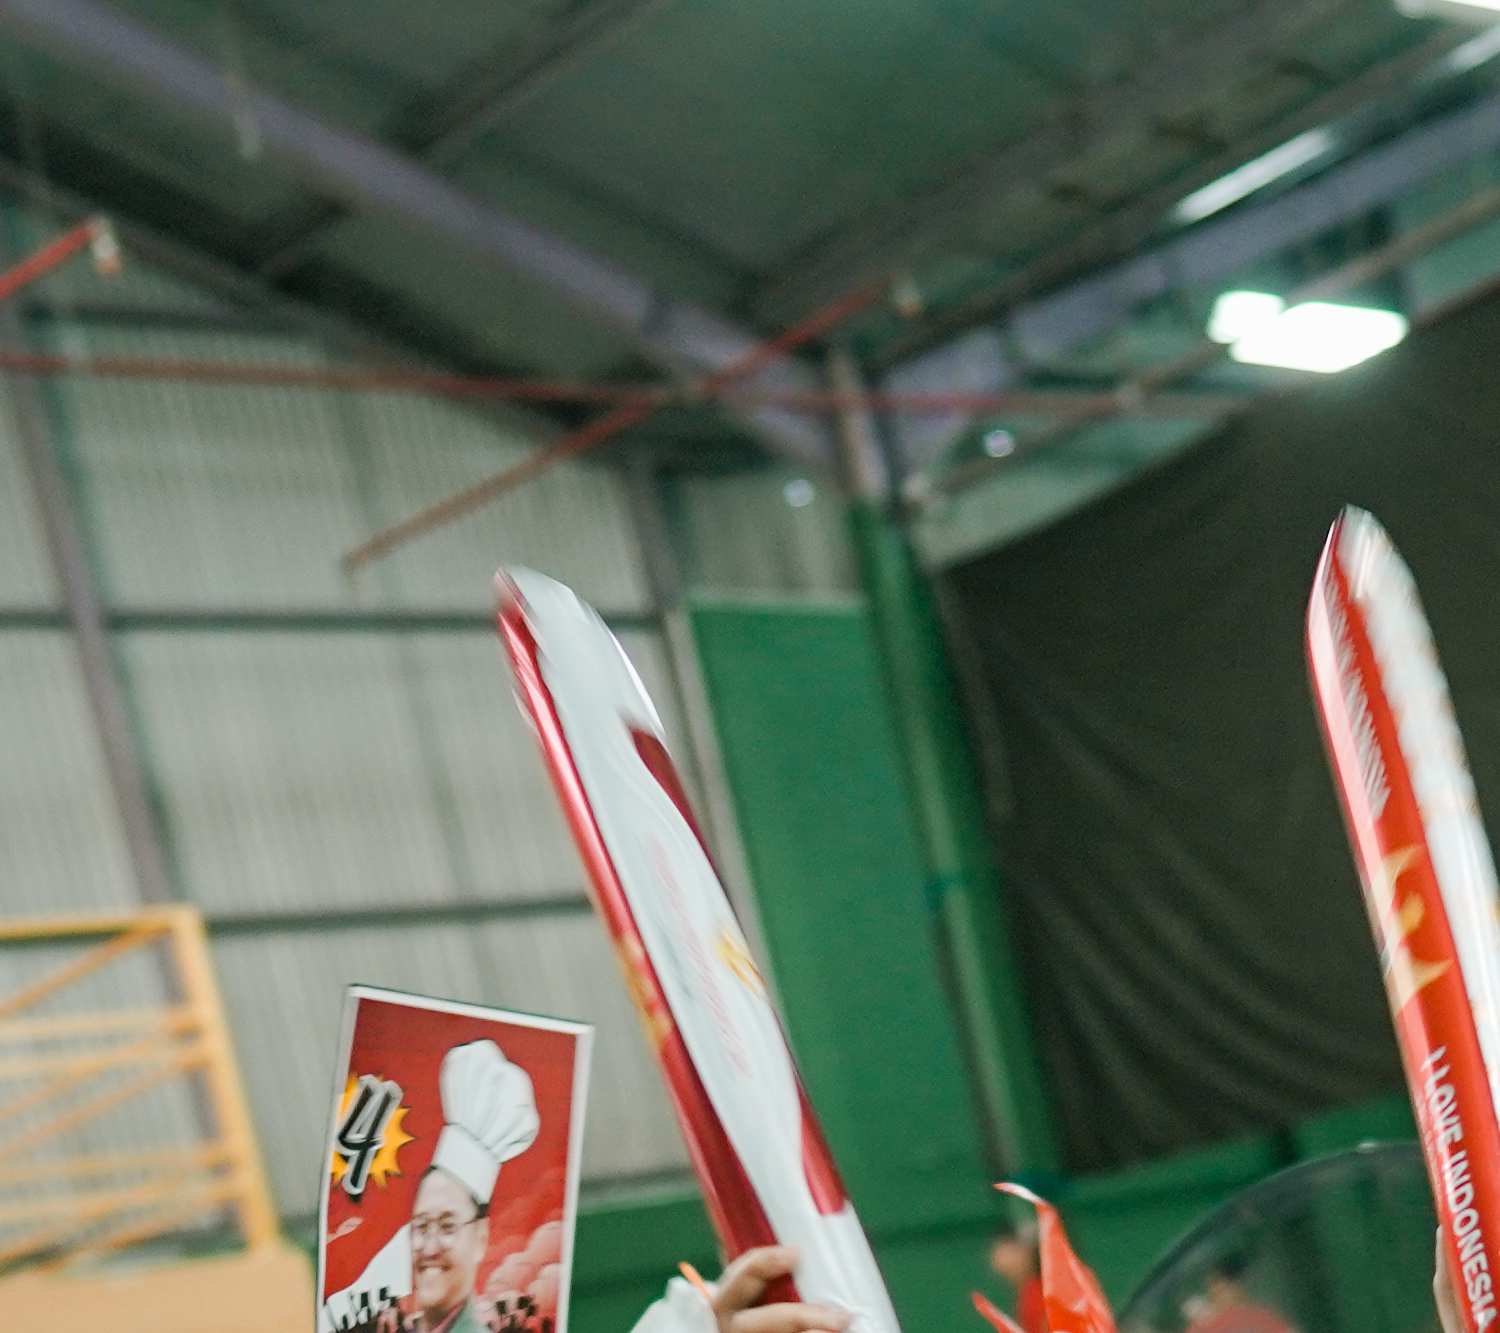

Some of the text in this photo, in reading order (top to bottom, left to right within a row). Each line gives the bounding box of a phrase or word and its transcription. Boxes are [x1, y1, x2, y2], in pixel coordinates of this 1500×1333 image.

[1420, 1046, 1447, 1071] I
[338, 1075, 404, 1195] 4
[1424, 1065, 1463, 1152] LOVE
